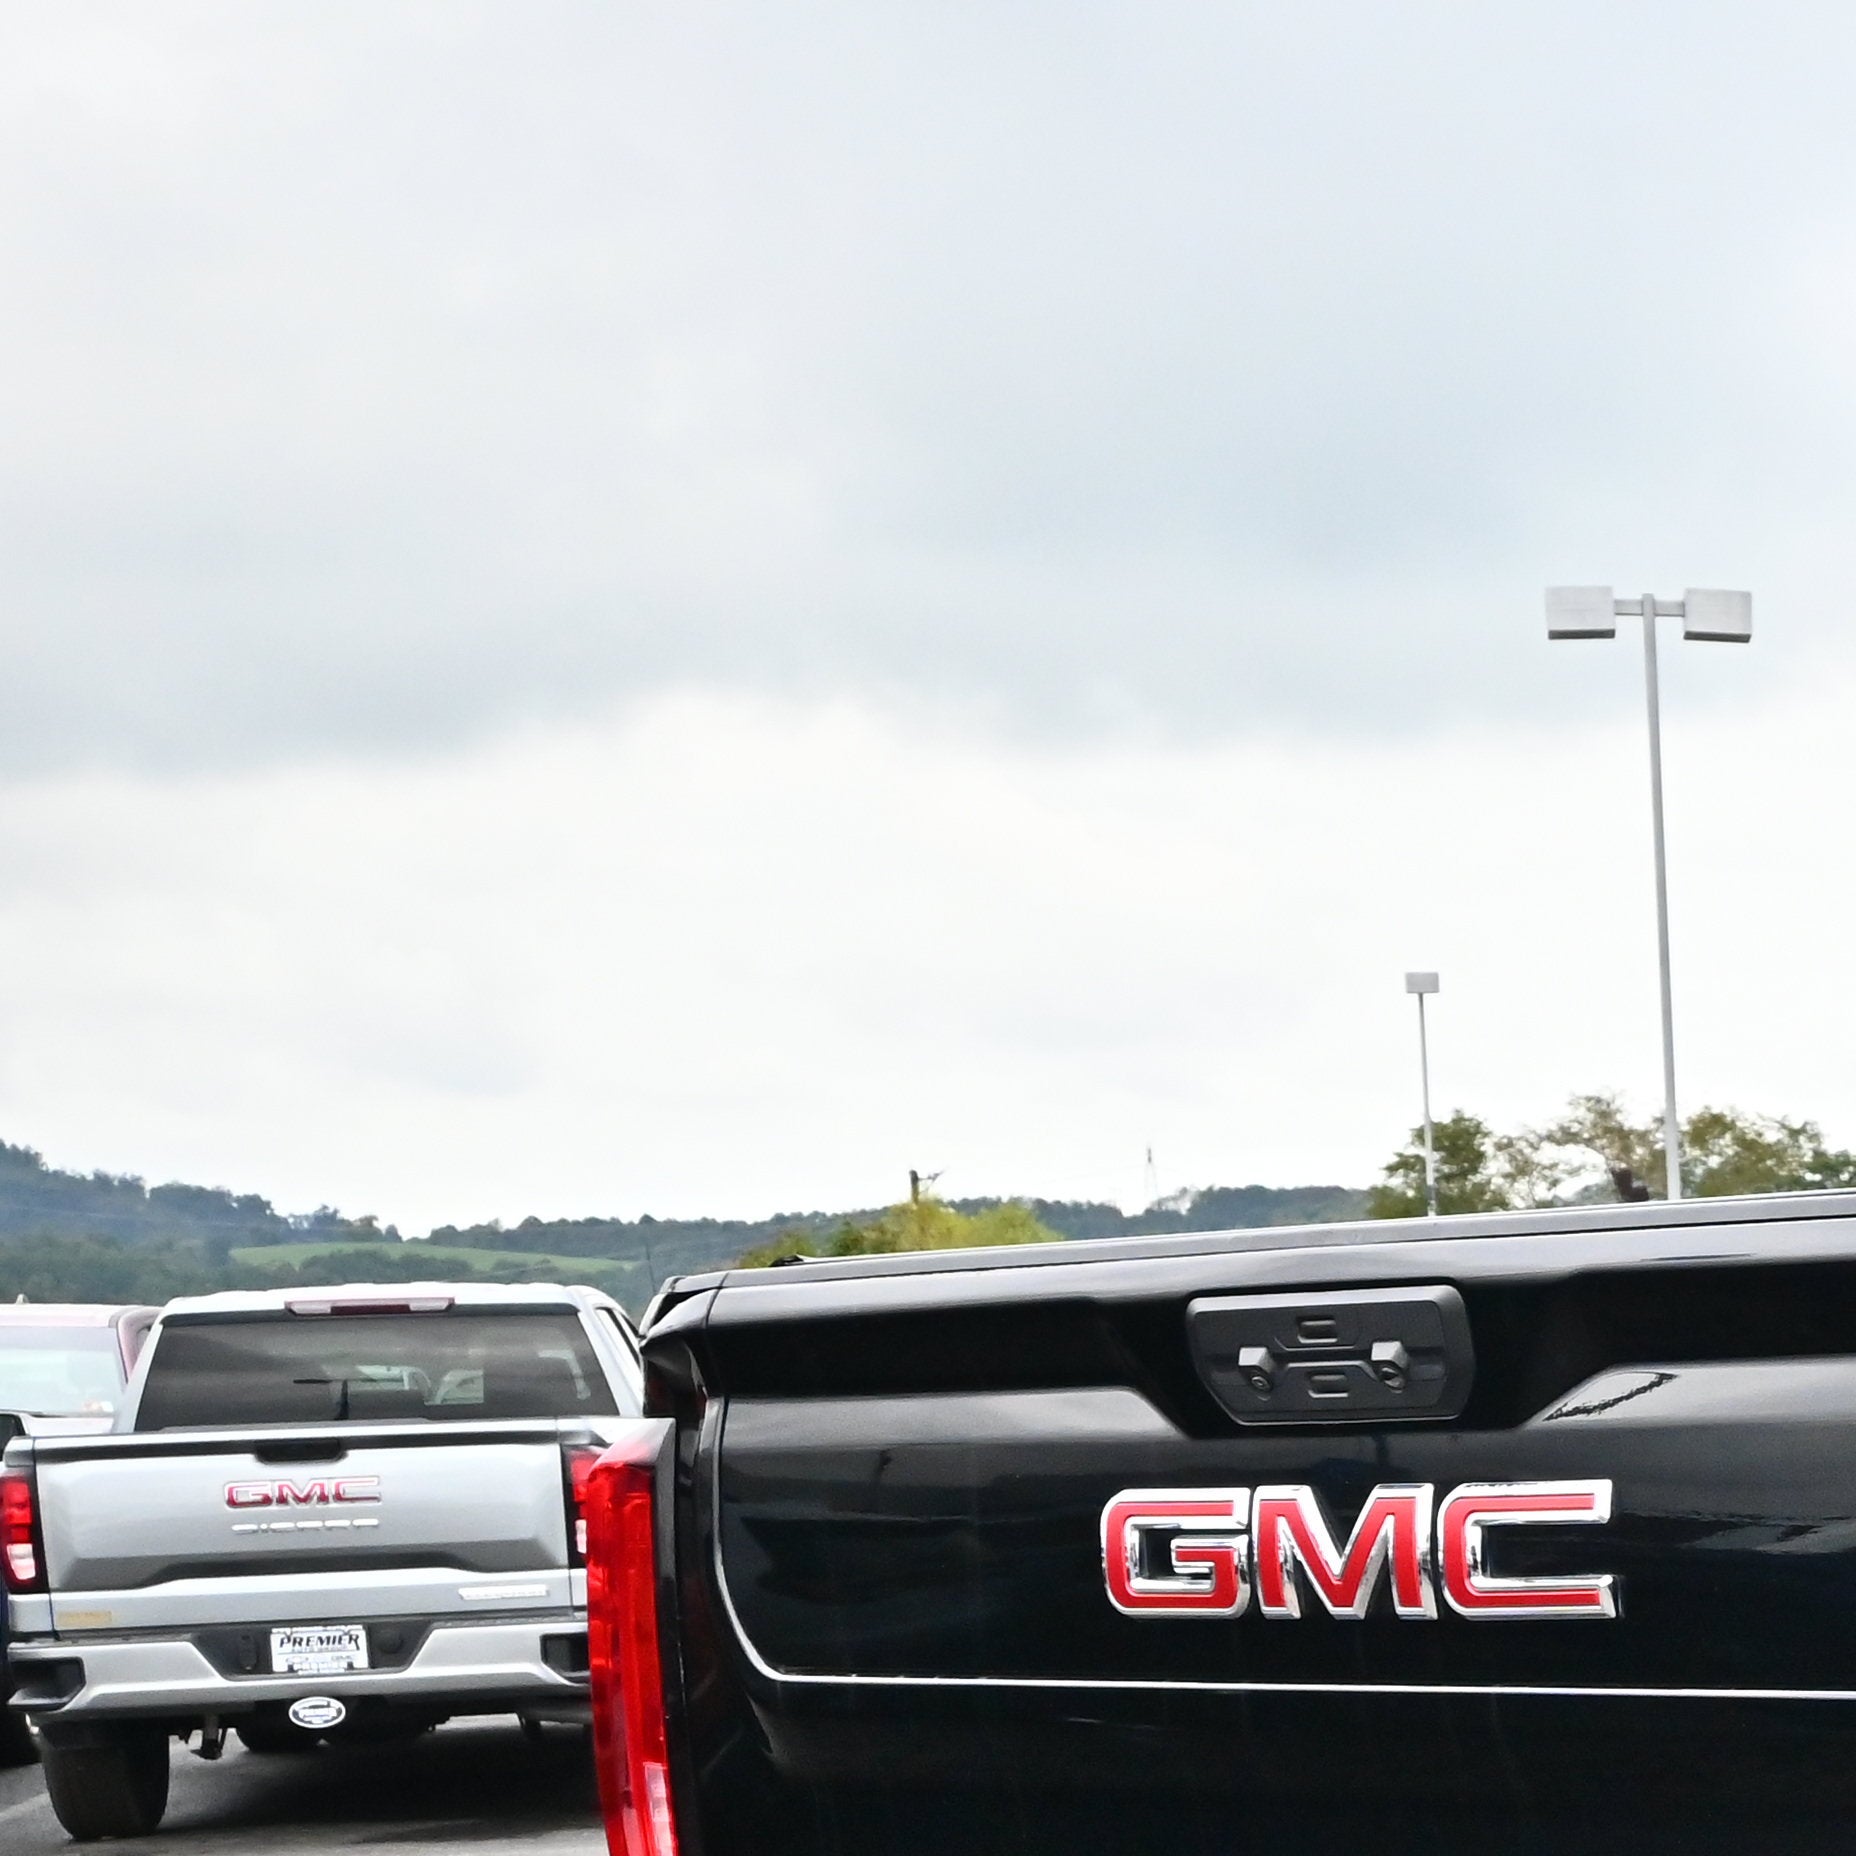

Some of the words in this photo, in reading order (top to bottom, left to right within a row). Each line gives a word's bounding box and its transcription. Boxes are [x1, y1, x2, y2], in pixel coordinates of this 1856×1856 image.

[225, 1476, 381, 1508] GMC
[1101, 1478, 1620, 1620] GMC
[279, 1634, 360, 1649] PREMIER
